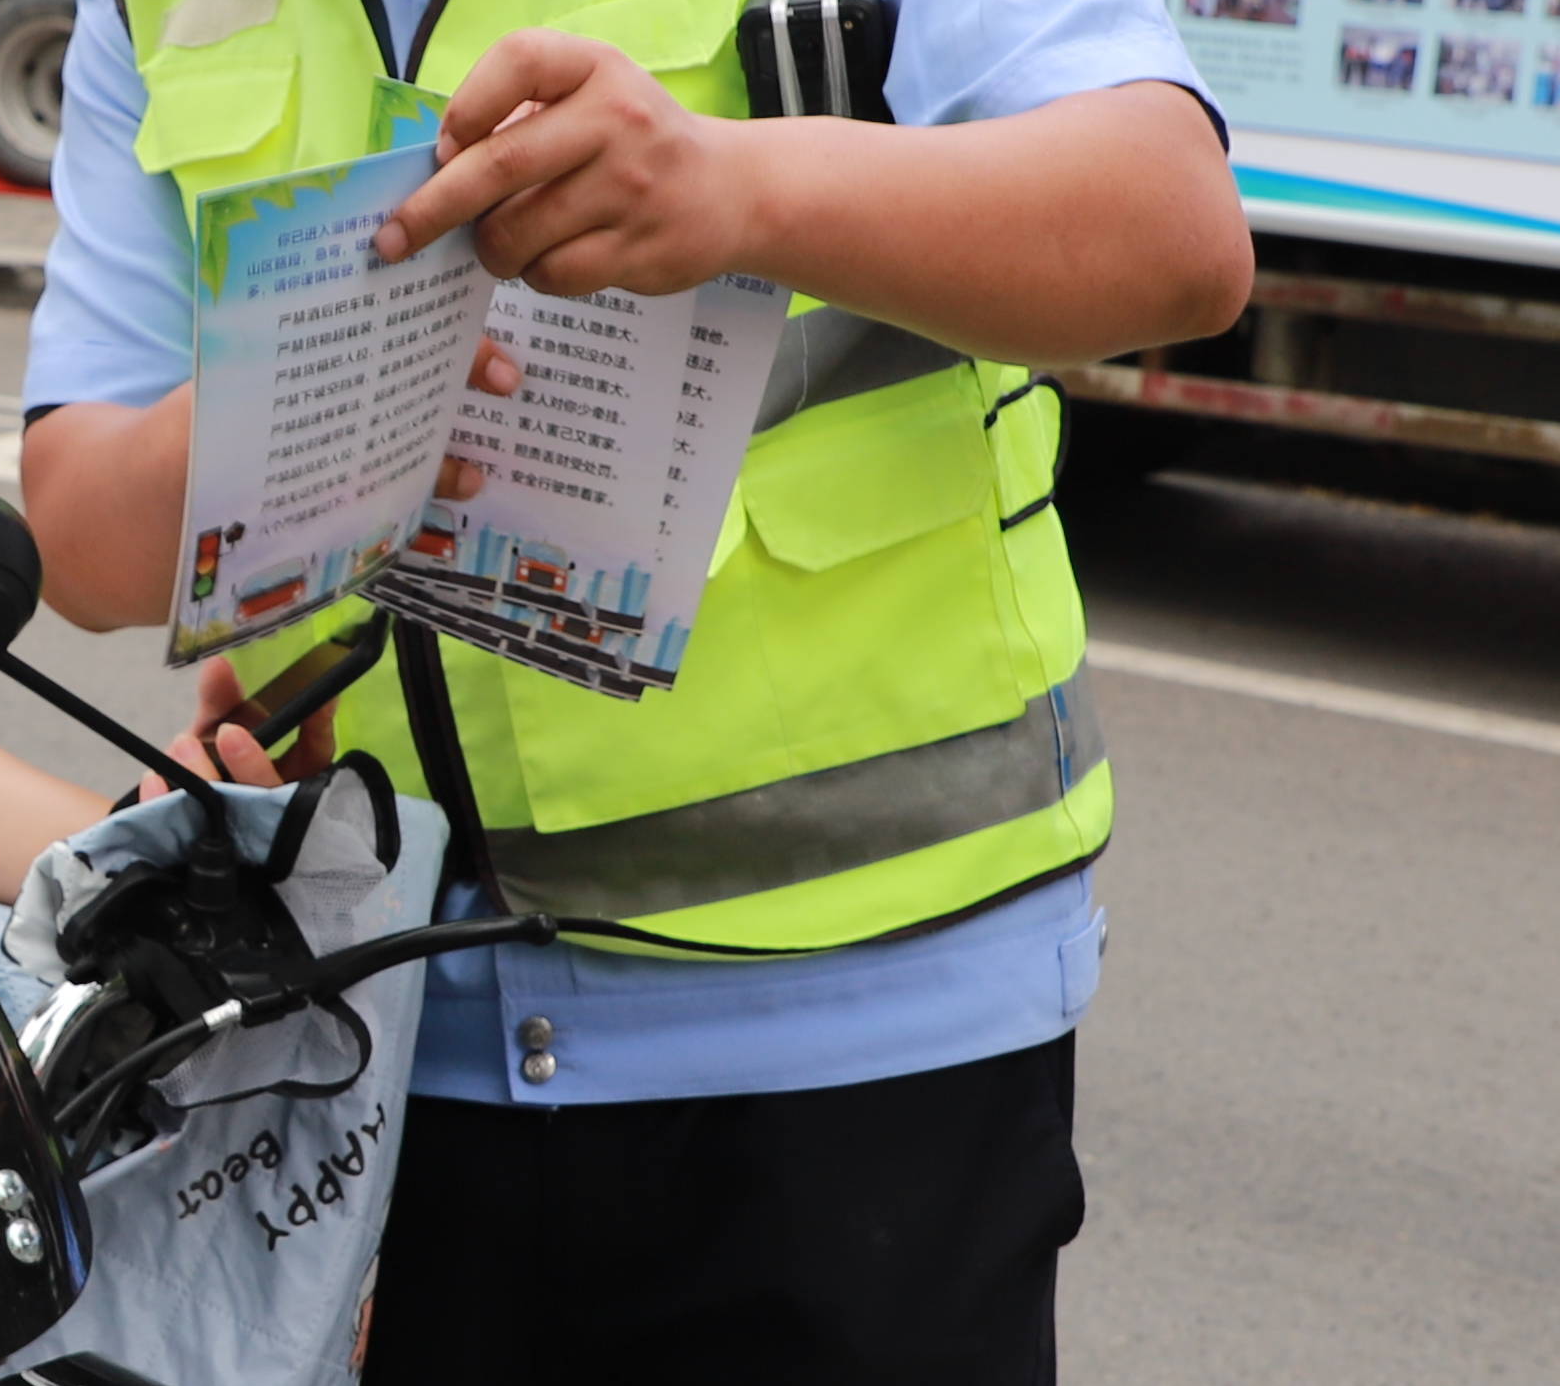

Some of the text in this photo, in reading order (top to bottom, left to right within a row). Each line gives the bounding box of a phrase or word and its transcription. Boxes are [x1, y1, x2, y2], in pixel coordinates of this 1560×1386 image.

[277, 207, 394, 249] 你已进入淄博市博
[482, 324, 635, 372] 挡滑，紧急情况没办法。
[457, 403, 623, 453] 把人拉，害人害己又害家。
[255, 1101, 387, 1253] HAPPY
